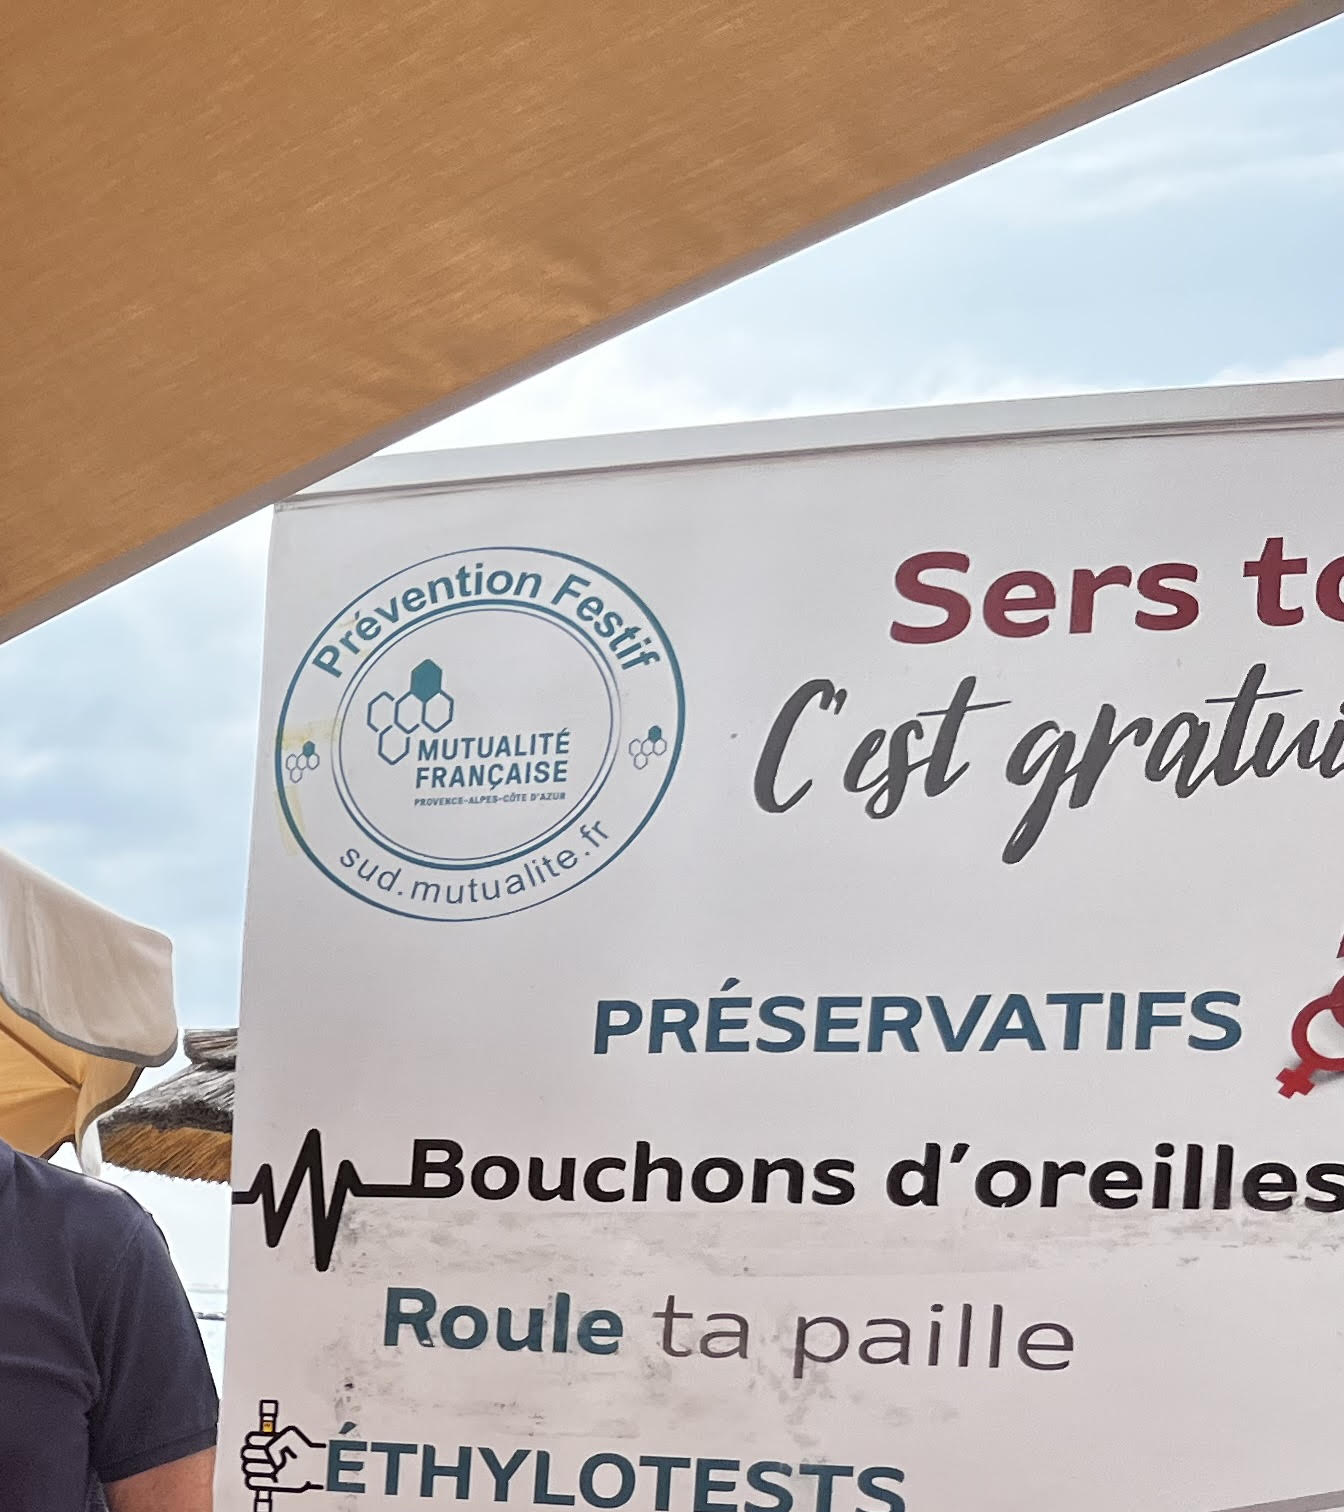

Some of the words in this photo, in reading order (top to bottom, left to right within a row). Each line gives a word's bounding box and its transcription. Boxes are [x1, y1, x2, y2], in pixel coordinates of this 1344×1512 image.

[312, 562, 543, 678] Prévention
[551, 572, 661, 671] Festif
[890, 549, 1200, 647] Sers
[415, 759, 569, 791] FRANÇAISE
[417, 727, 570, 762] MUTUALITÉ
[752, 675, 1013, 821] C'est
[529, 791, 567, 803] D'AZUR
[339, 820, 610, 905] sud.mutualite.fr
[593, 978, 1244, 1056] PRÉSERVATIFS
[410, 1137, 857, 1208] Bouchons
[885, 1142, 1344, 1214] d'oreilles
[383, 1286, 625, 1355] Roule
[653, 1292, 752, 1362] ta
[793, 1303, 1076, 1378] paille
